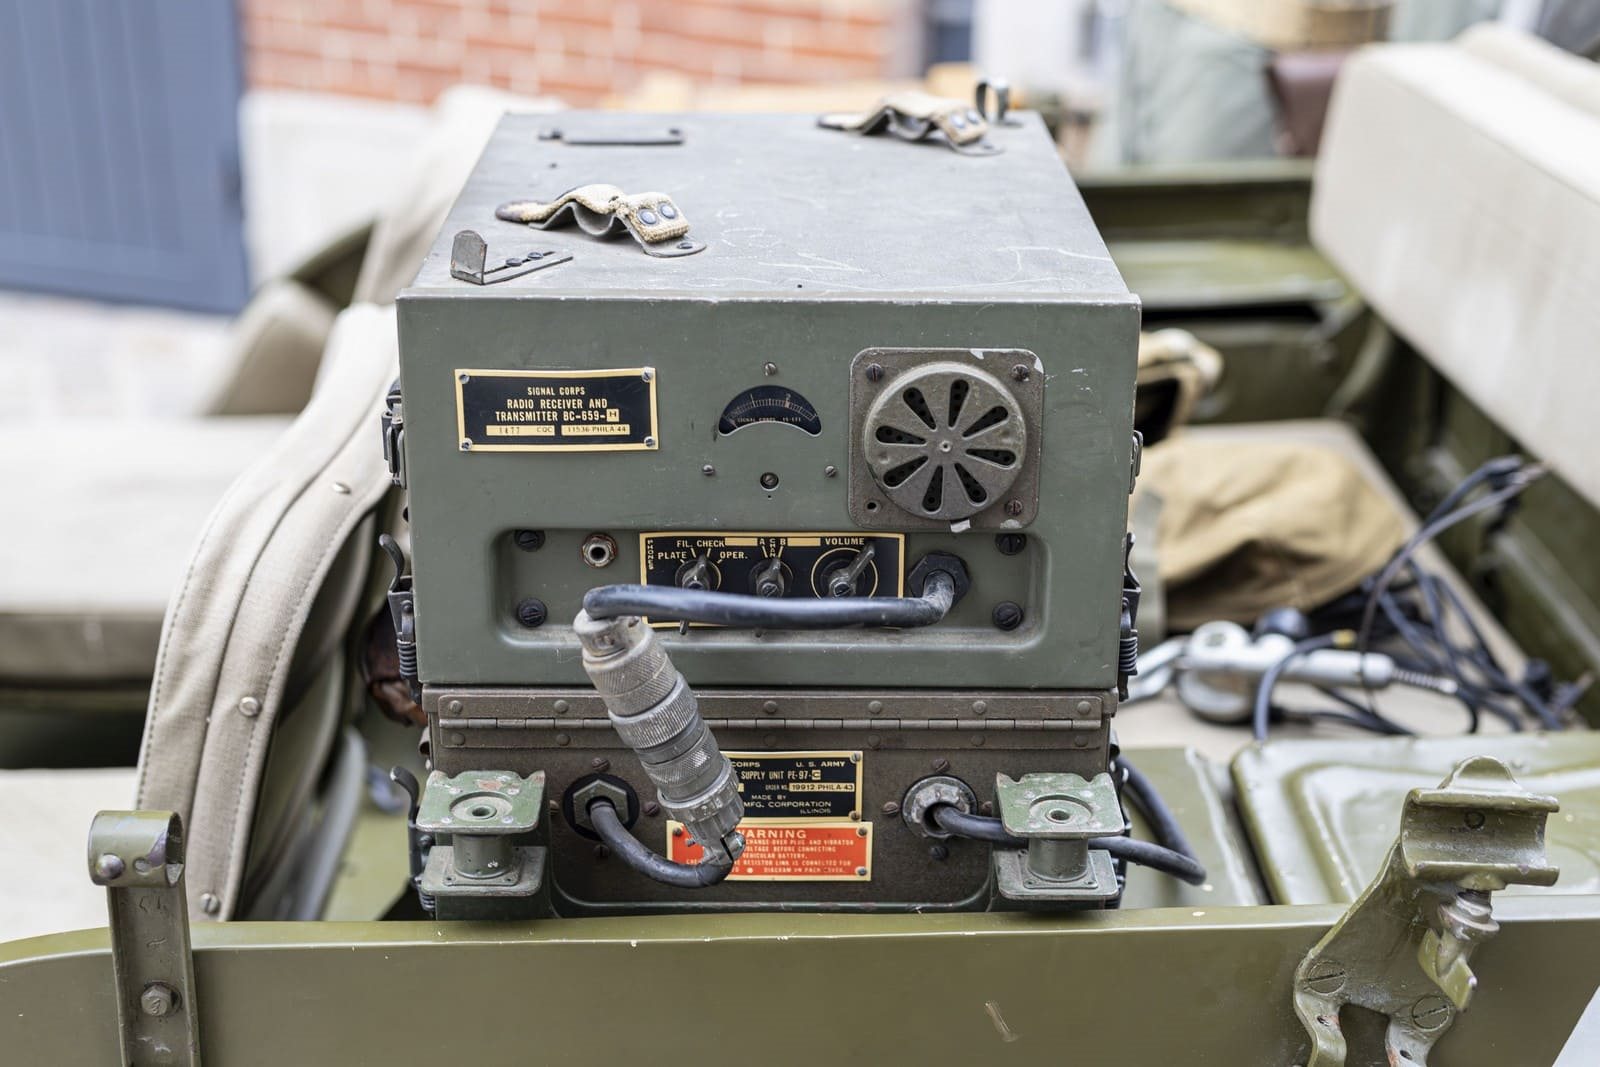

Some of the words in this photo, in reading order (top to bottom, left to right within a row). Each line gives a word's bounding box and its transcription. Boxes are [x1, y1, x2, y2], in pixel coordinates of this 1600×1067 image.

[527, 387, 555, 396] SIGNAL
[559, 386, 586, 396] CORPS
[507, 399, 534, 409] RADIO
[540, 399, 583, 409] RECEIVER
[589, 398, 608, 409] AND
[495, 411, 558, 422] TRANSMITTER
[676, 540, 693, 548] FIL.
[697, 540, 726, 548] CHECK
[658, 551, 687, 559] PLATE
[741, 770, 765, 780] SUPPLY
[769, 770, 784, 780] UNIT
